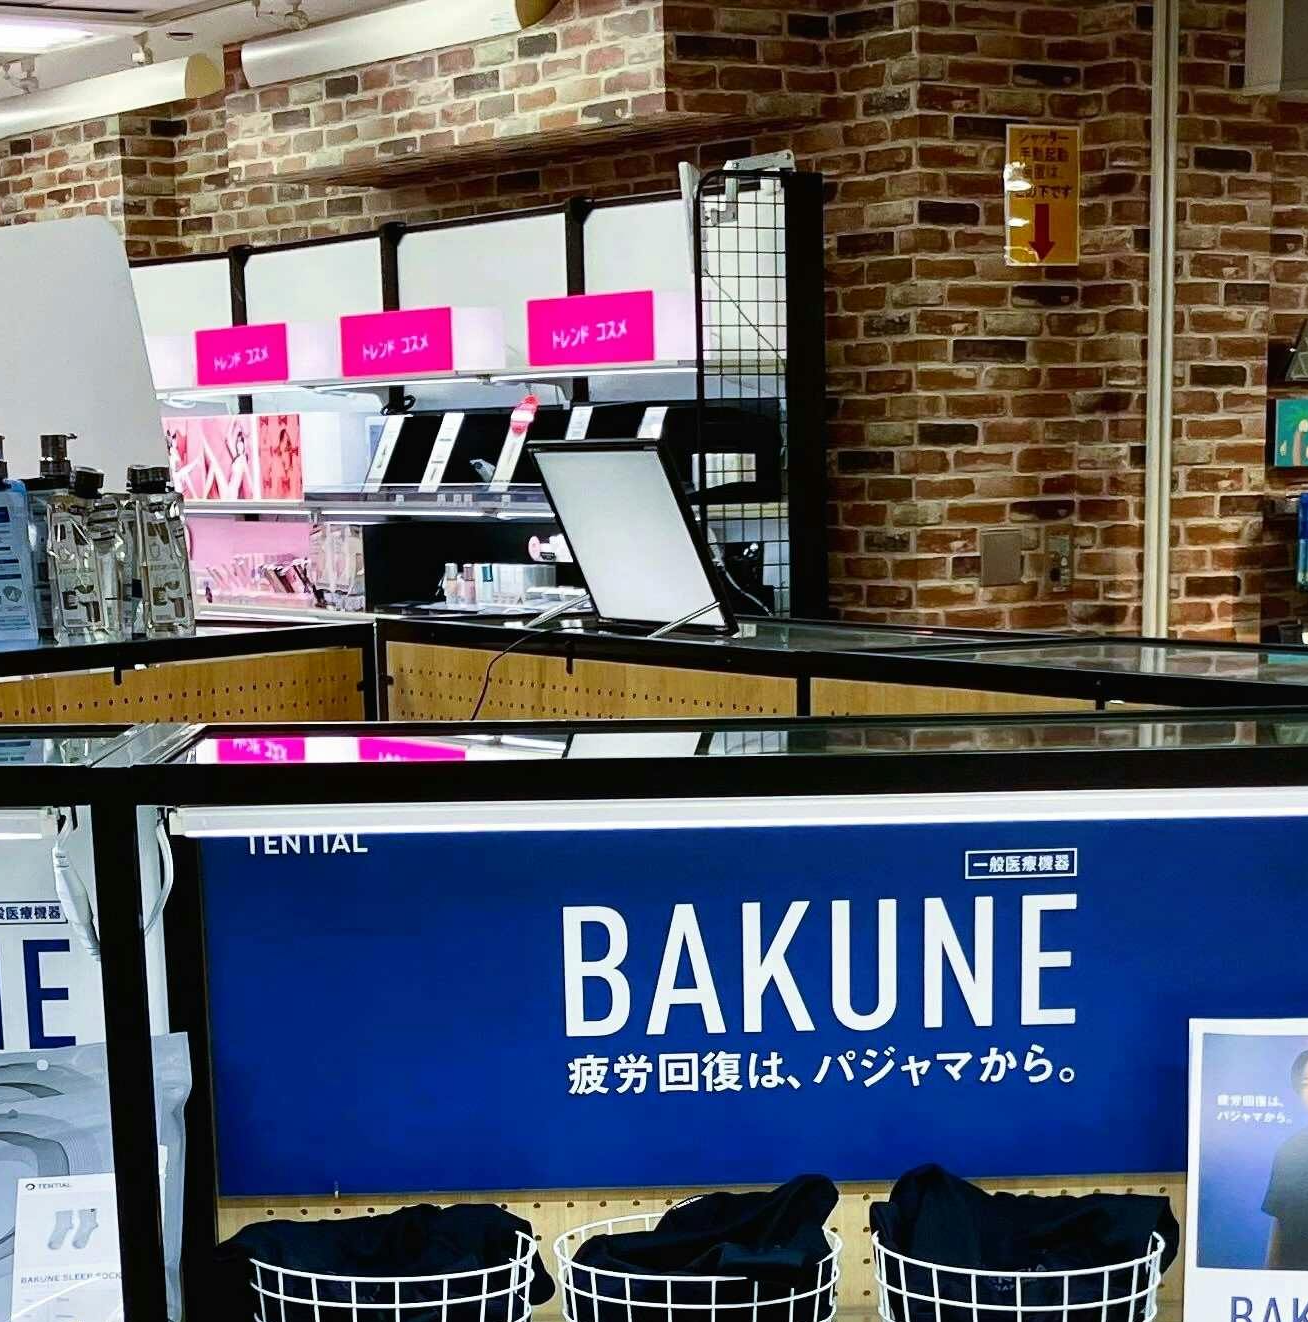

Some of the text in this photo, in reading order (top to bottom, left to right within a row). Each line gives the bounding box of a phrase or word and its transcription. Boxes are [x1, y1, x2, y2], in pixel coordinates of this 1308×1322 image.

[362, 334, 430, 361] トレンド コスメ
[552, 319, 629, 349] トレンド コスメ
[214, 346, 270, 371] トレンド コスメ
[972, 854, 1071, 876] 一般医療機器
[561, 893, 1078, 1039] BAKUNE
[567, 1043, 1078, 1096] 疲労回復は、パジャマから。
